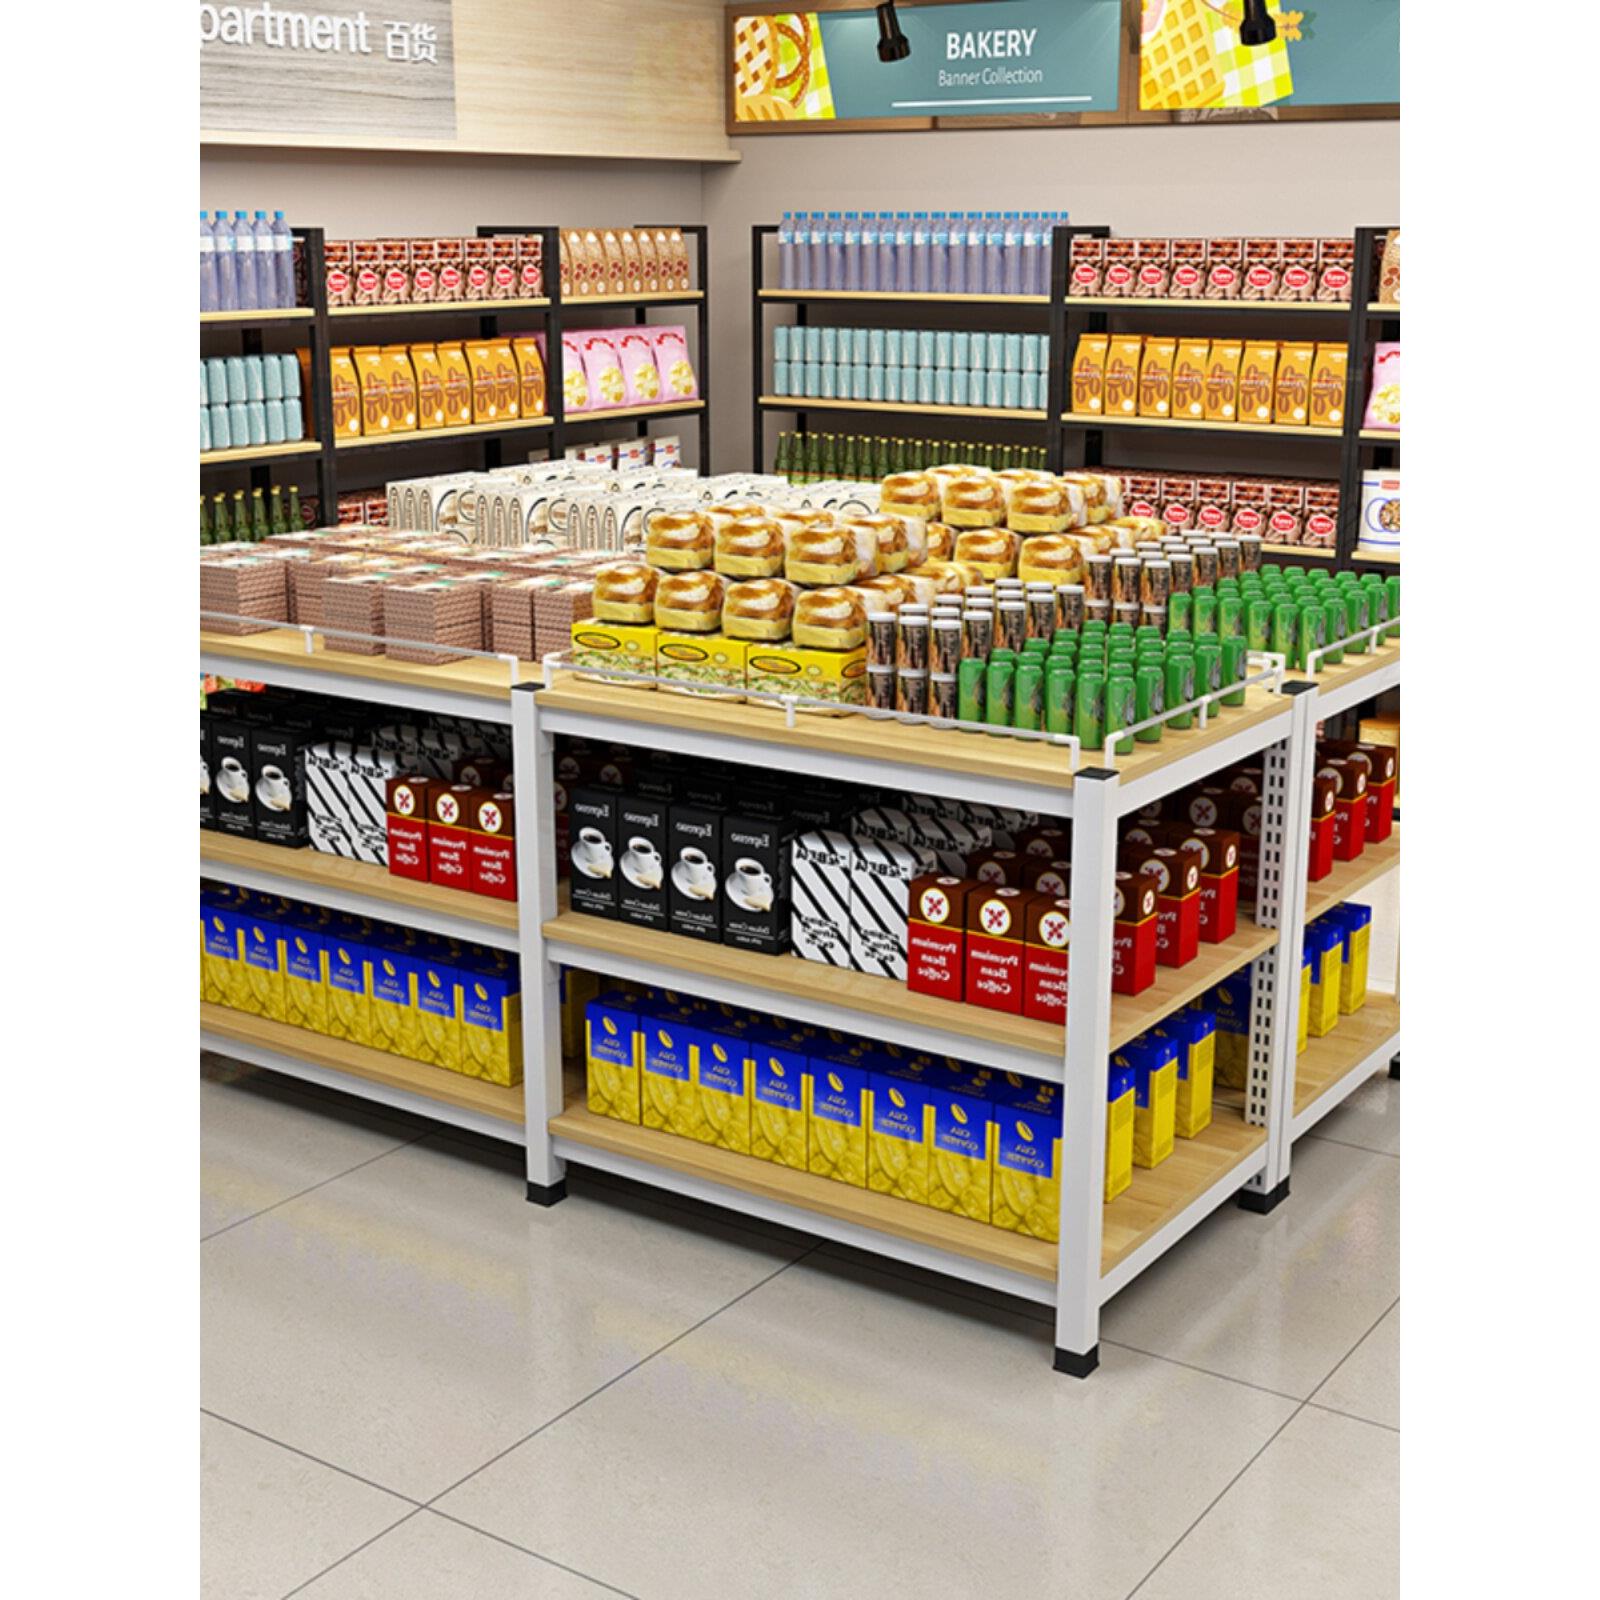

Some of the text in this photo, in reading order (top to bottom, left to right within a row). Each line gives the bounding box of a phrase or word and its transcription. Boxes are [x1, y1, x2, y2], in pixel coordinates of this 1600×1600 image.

[383, 20, 438, 64] 百货
[946, 28, 1037, 60] BAKERY
[938, 66, 1043, 87] Banner Collection
